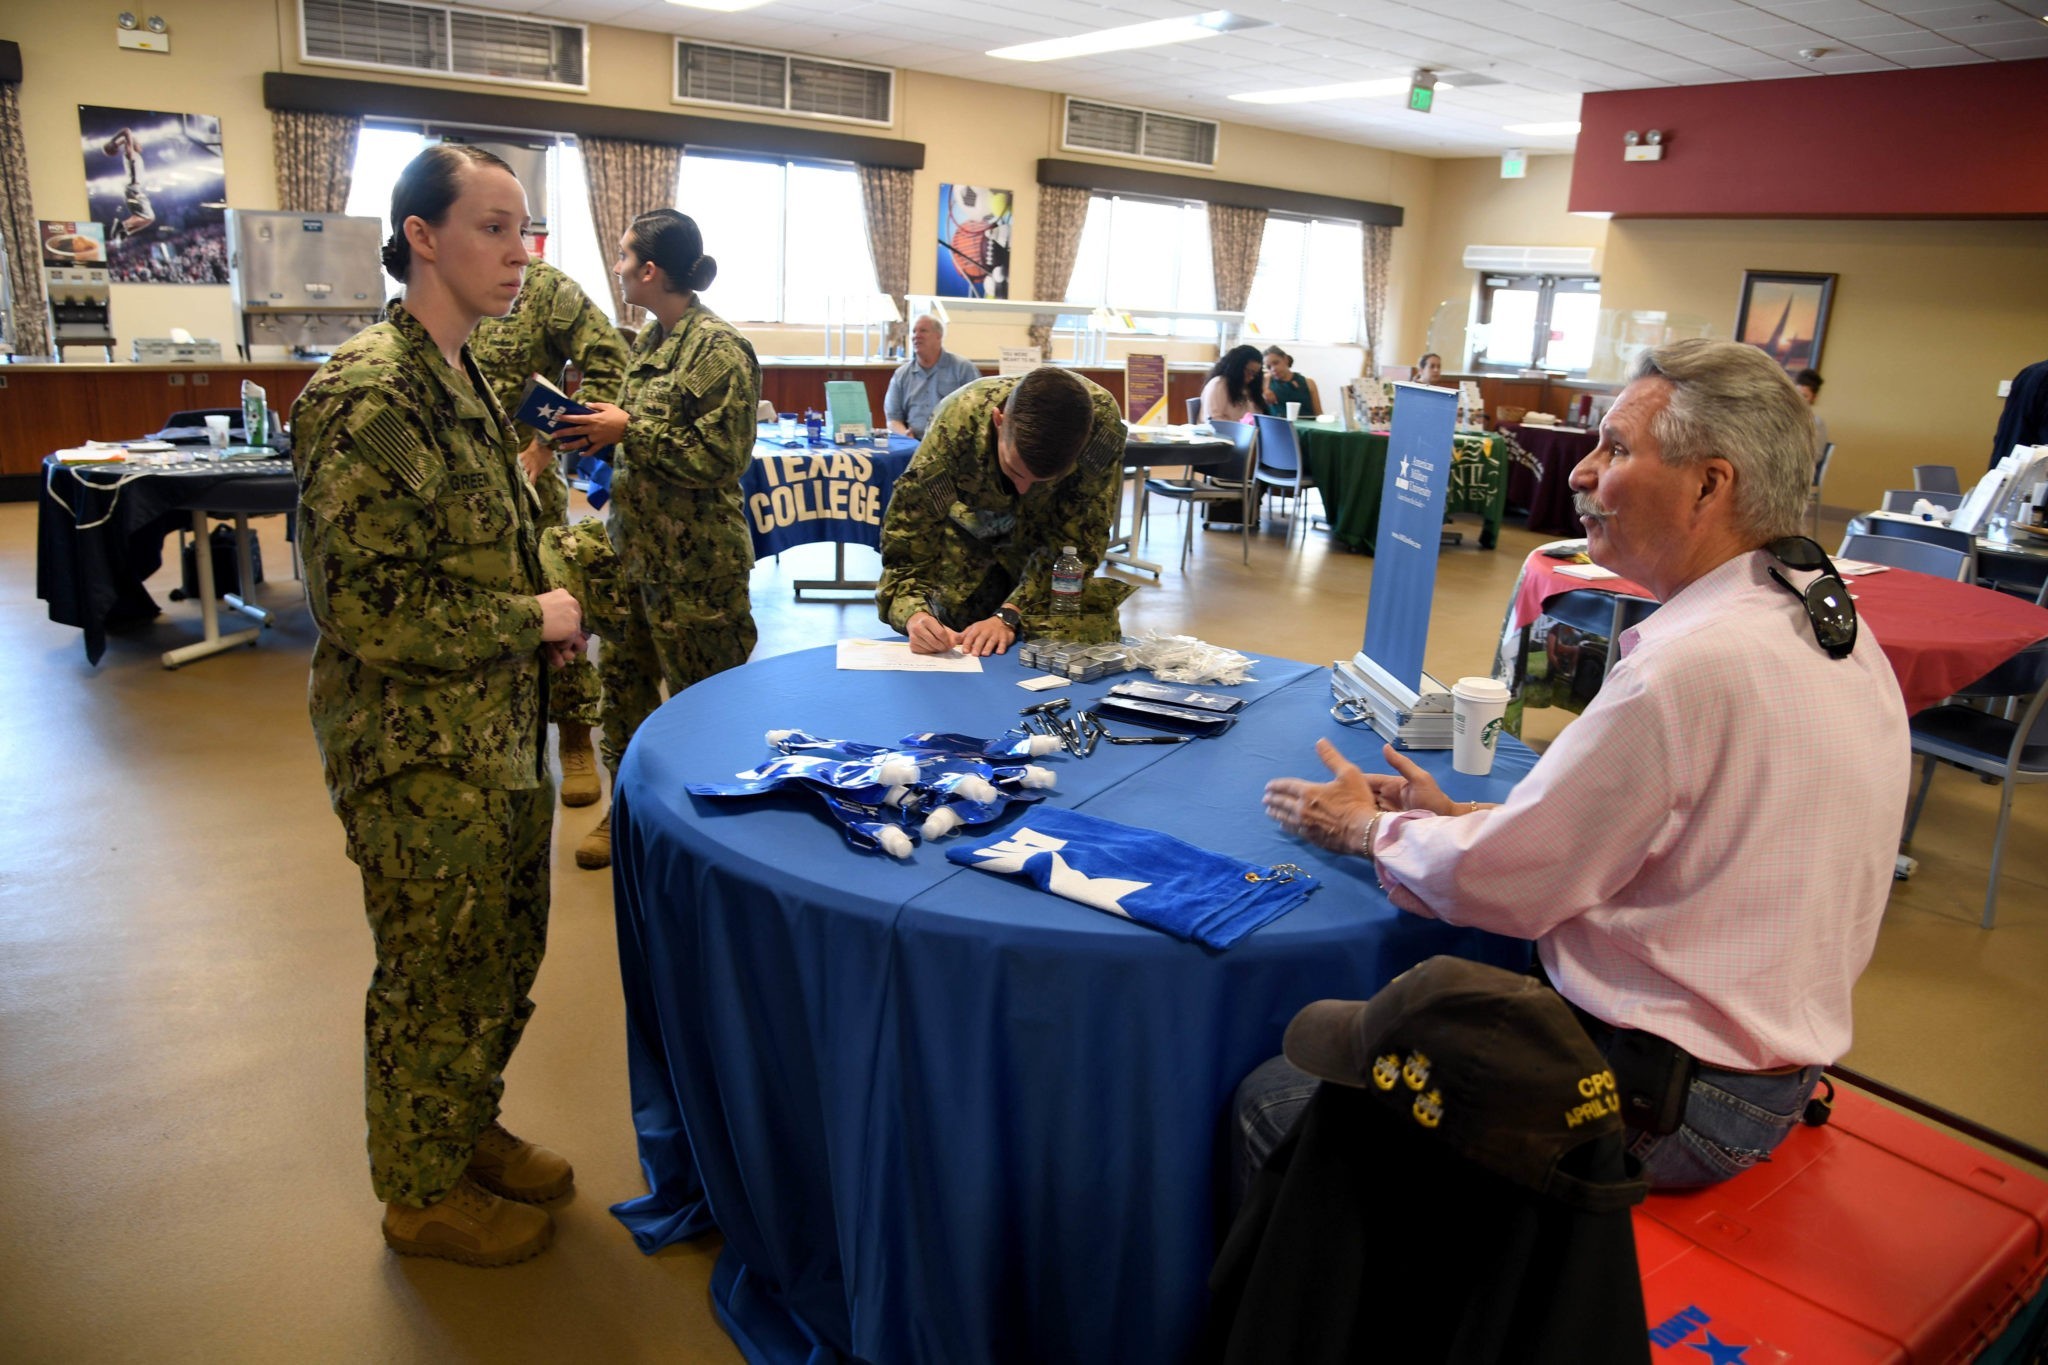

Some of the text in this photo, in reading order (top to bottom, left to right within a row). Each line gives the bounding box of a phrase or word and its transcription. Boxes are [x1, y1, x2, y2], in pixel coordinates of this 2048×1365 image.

[754, 450, 873, 487] TEXAS
[749, 480, 880, 534] COLLEGE
[1578, 1070, 1616, 1098] CPO
[1565, 1098, 1609, 1129] APRIL
[1648, 1305, 1712, 1349] AMU
